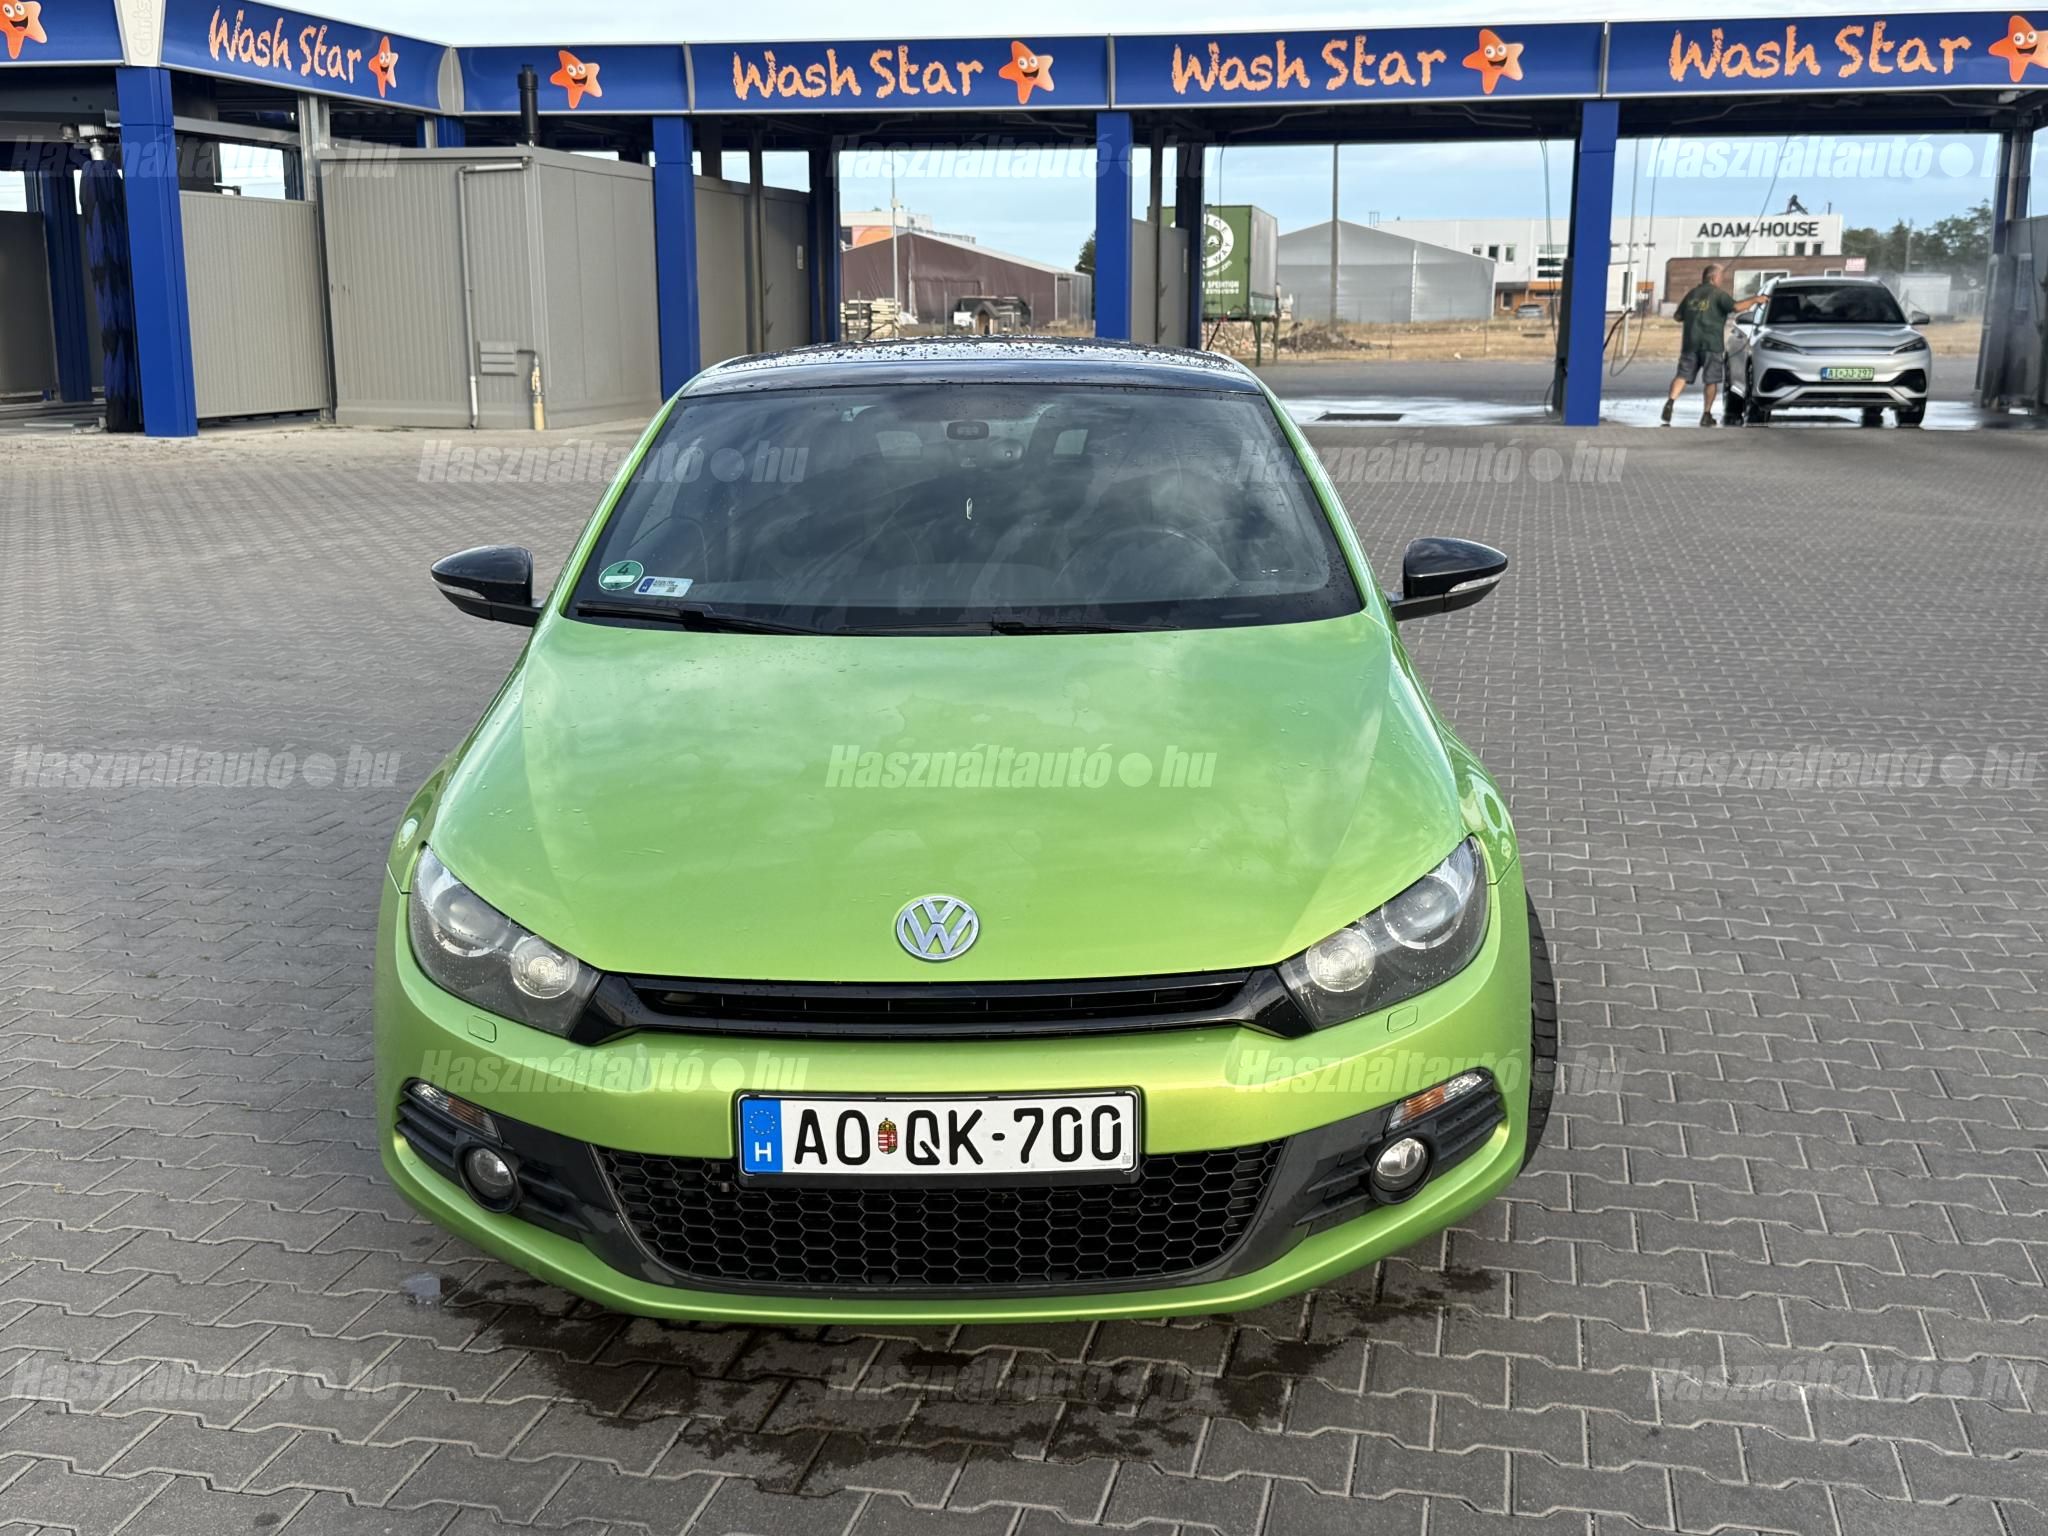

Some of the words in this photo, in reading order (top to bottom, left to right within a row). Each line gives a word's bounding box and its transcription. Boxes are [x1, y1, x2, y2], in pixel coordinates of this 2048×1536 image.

[208, 5, 291, 72] Wash
[299, 26, 363, 83] Star
[1172, 39, 1310, 94] Wash
[1321, 35, 1446, 91] Star
[1668, 25, 1822, 82] Wash
[1835, 21, 1972, 78] Star
[732, 48, 861, 100] Wash
[870, 45, 984, 97] Star
[1697, 222, 1819, 237] ADAM-HOUSE
[617, 562, 631, 575] 4
[755, 1142, 772, 1162] H
